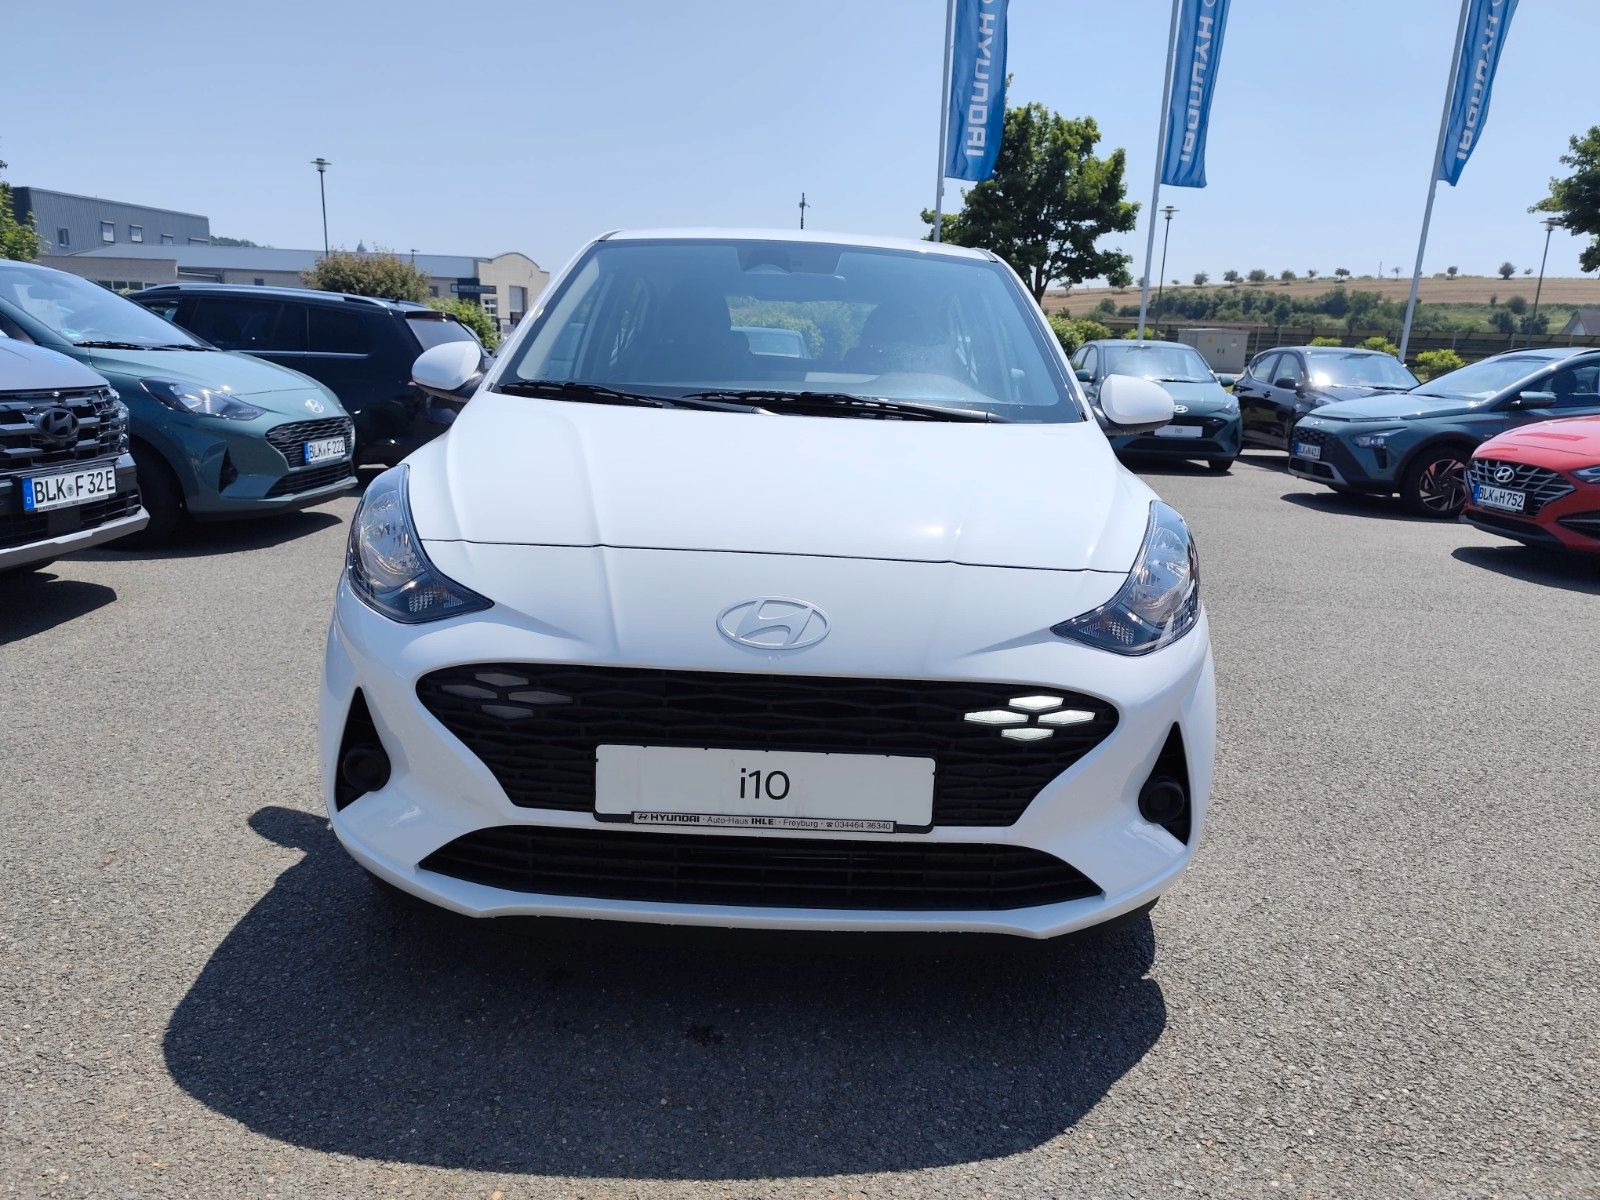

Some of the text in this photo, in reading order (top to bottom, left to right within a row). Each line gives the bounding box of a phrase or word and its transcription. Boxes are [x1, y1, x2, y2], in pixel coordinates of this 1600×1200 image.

[966, 12, 996, 157] HYUNDAI
[1179, 15, 1214, 162] HYUNDAI
[1456, 14, 1499, 160] HYUNDAI
[650, 813, 700, 823] HYUNDAI
[706, 815, 749, 825] Auto-Haus
[751, 817, 774, 826] IHLE
[783, 819, 818, 829] Freyburg
[739, 767, 790, 801] i10
